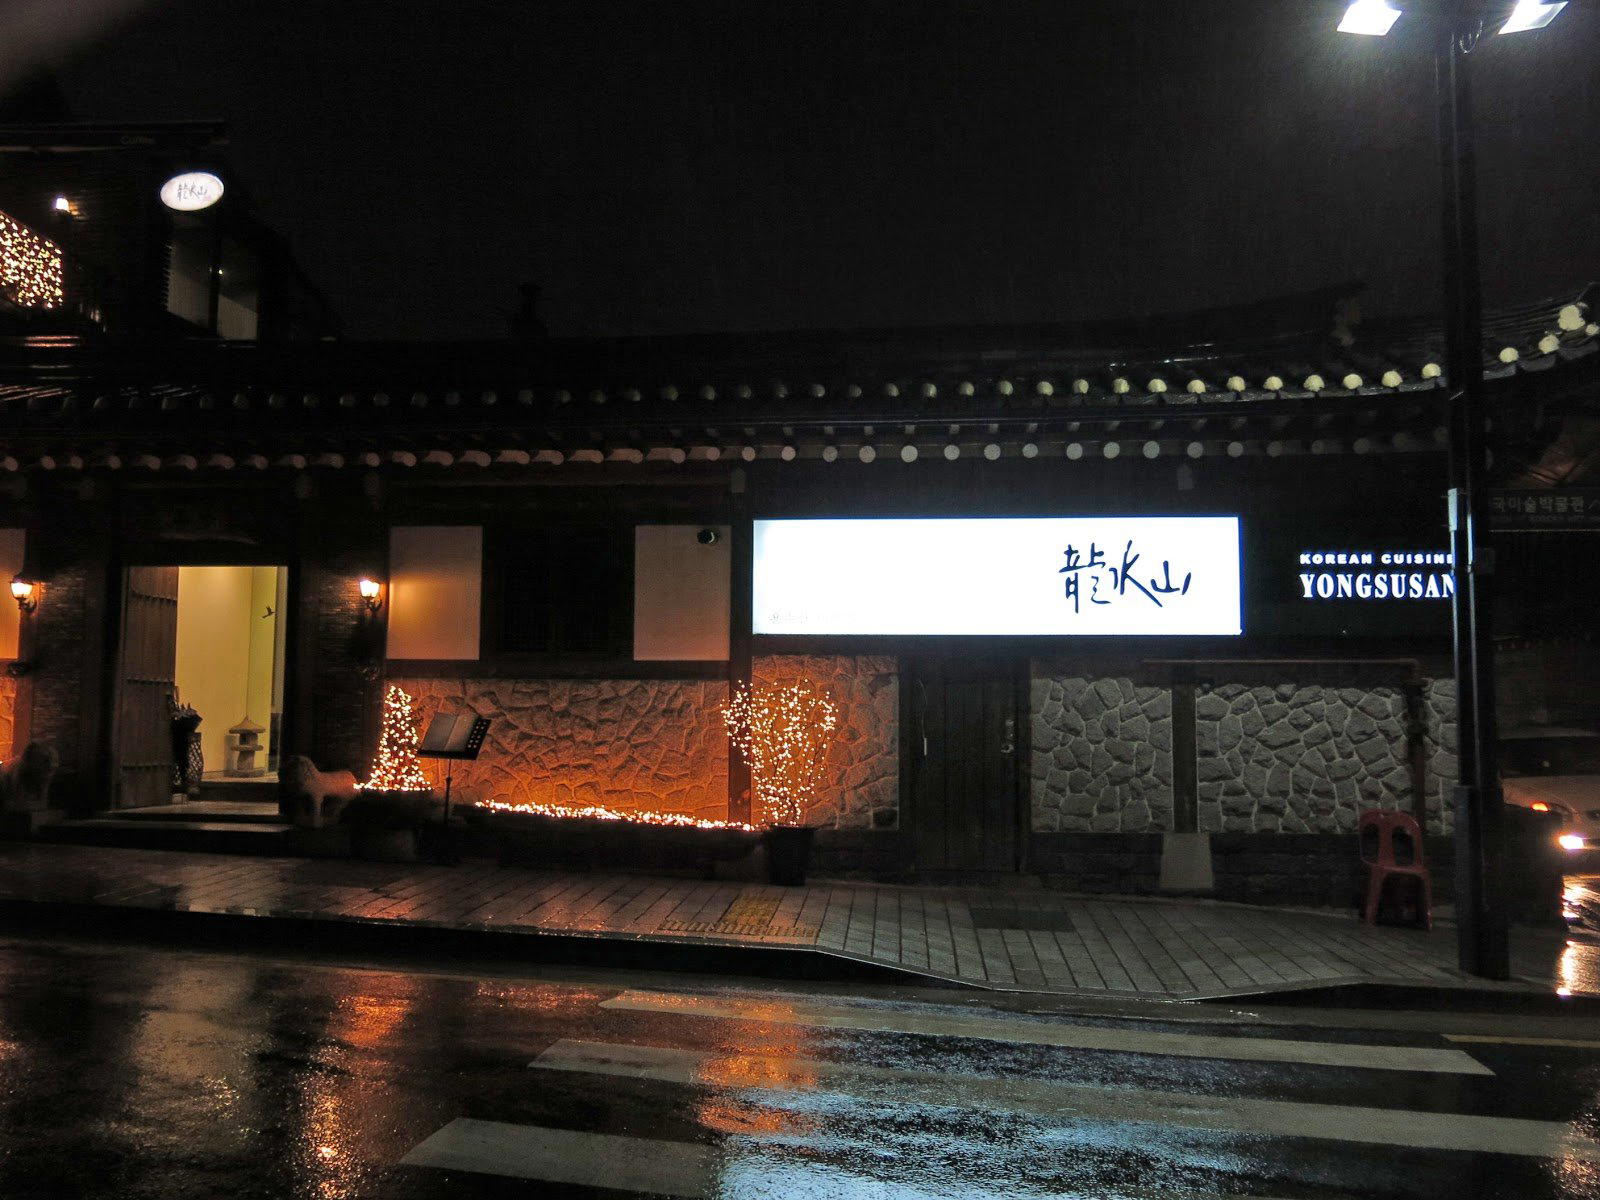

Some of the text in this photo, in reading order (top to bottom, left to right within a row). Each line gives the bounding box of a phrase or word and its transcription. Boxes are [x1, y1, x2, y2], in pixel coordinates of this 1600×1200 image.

[1488, 496, 1584, 512] 국미술박물관
[1299, 553, 1372, 564] KOREAN
[1299, 573, 1454, 598] YONGSUSAN
